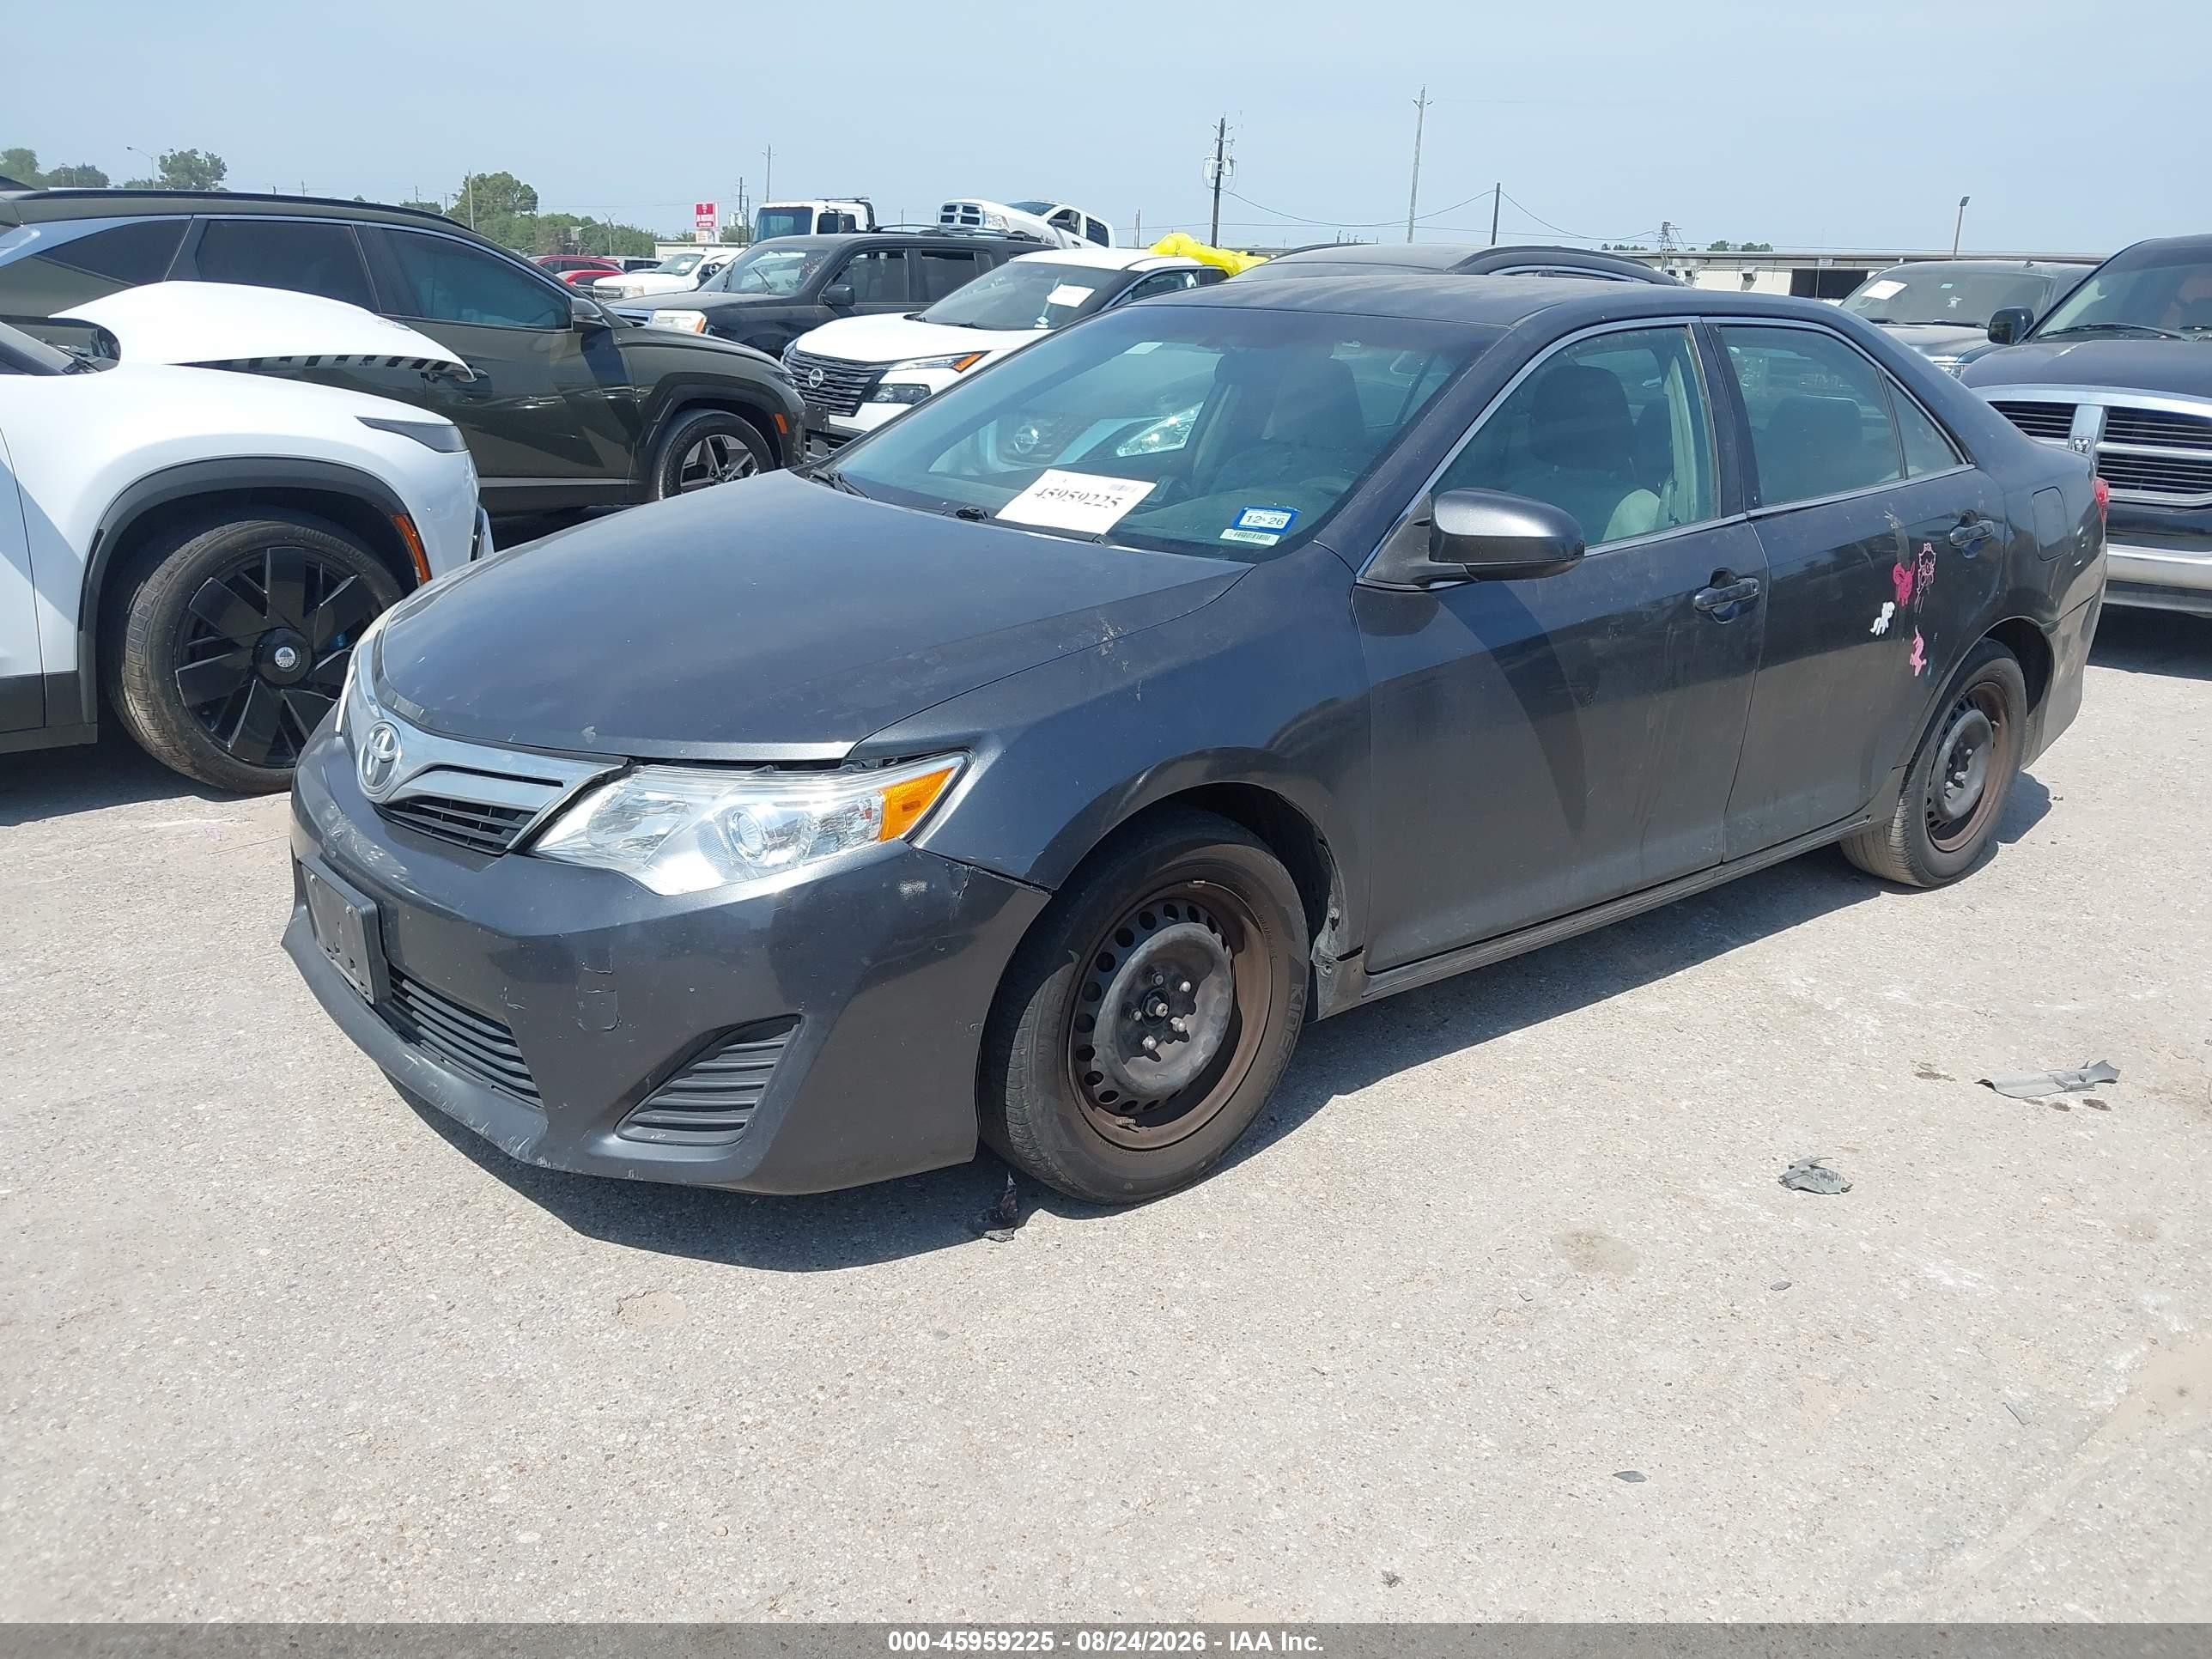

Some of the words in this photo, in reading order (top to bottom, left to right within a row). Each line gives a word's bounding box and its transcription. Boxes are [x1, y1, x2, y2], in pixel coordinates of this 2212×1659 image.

[1035, 487, 1123, 508] 45959225
[1246, 514, 1262, 524] 12
[1267, 516, 1285, 526] 26
